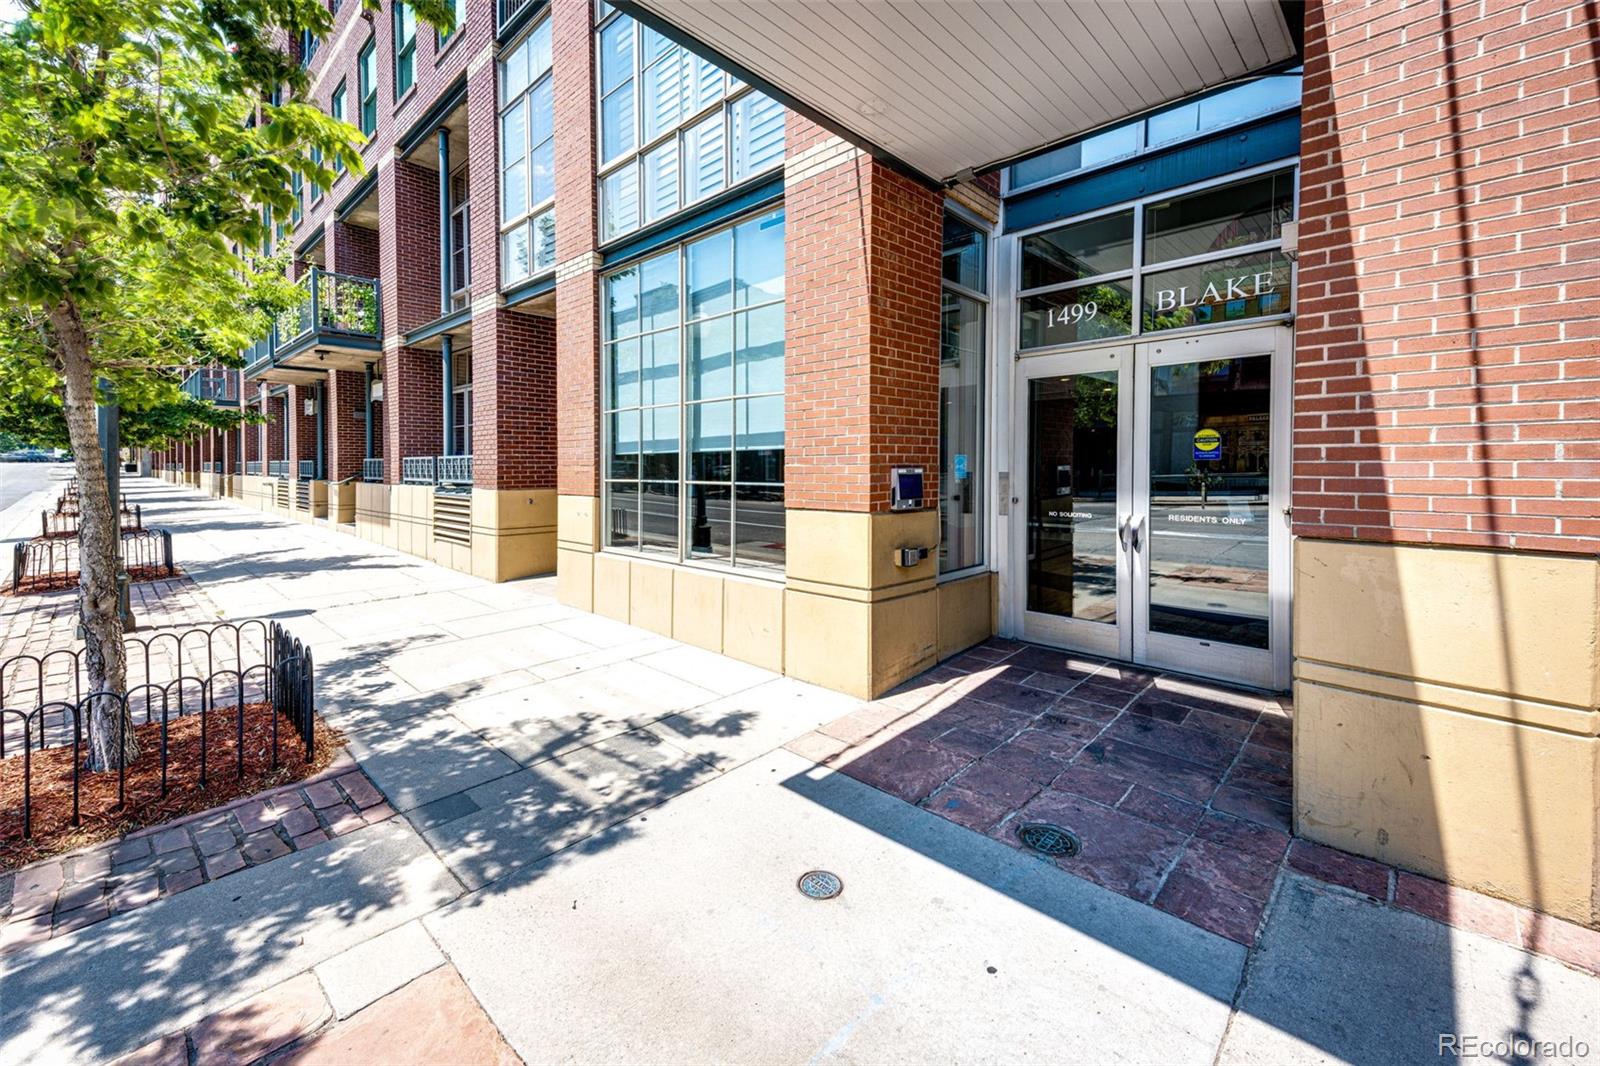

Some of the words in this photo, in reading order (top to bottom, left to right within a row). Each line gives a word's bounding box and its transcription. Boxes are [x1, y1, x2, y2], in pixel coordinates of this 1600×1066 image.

[1047, 301, 1098, 328] 1499
[1156, 271, 1276, 312] BLAKE
[1059, 511, 1093, 519] SOLICITING
[1168, 514, 1217, 524] RESIDENTS
[1222, 516, 1247, 525] ONLY
